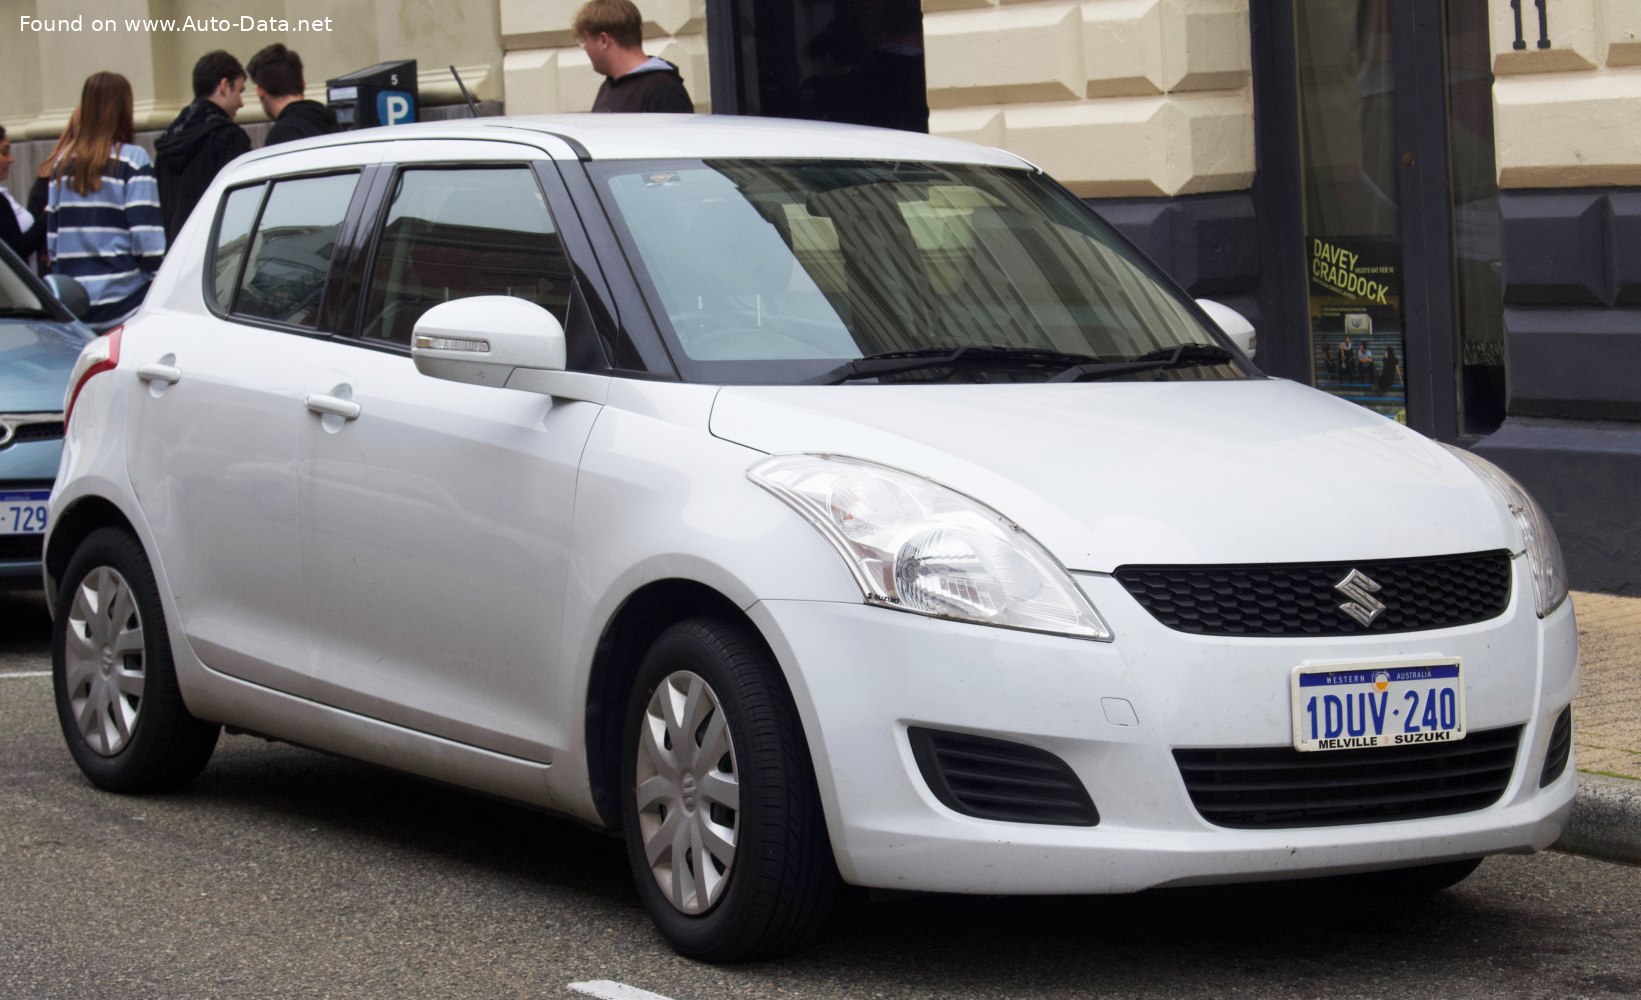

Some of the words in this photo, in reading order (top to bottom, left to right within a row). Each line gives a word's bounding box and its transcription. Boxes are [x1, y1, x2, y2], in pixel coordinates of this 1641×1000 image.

[390, 74, 398, 85] 5
[386, 96, 409, 126] P
[1314, 238, 1359, 271] DAVEY
[1313, 258, 1389, 304] CRADDOCK
[874, 594, 900, 604] SUZUKI
[1327, 675, 1365, 684] WESTERN
[1396, 671, 1432, 680] AUSTRALIA
[1319, 736, 1378, 750] MELVILLE
[1394, 731, 1450, 744] SUZUKI
